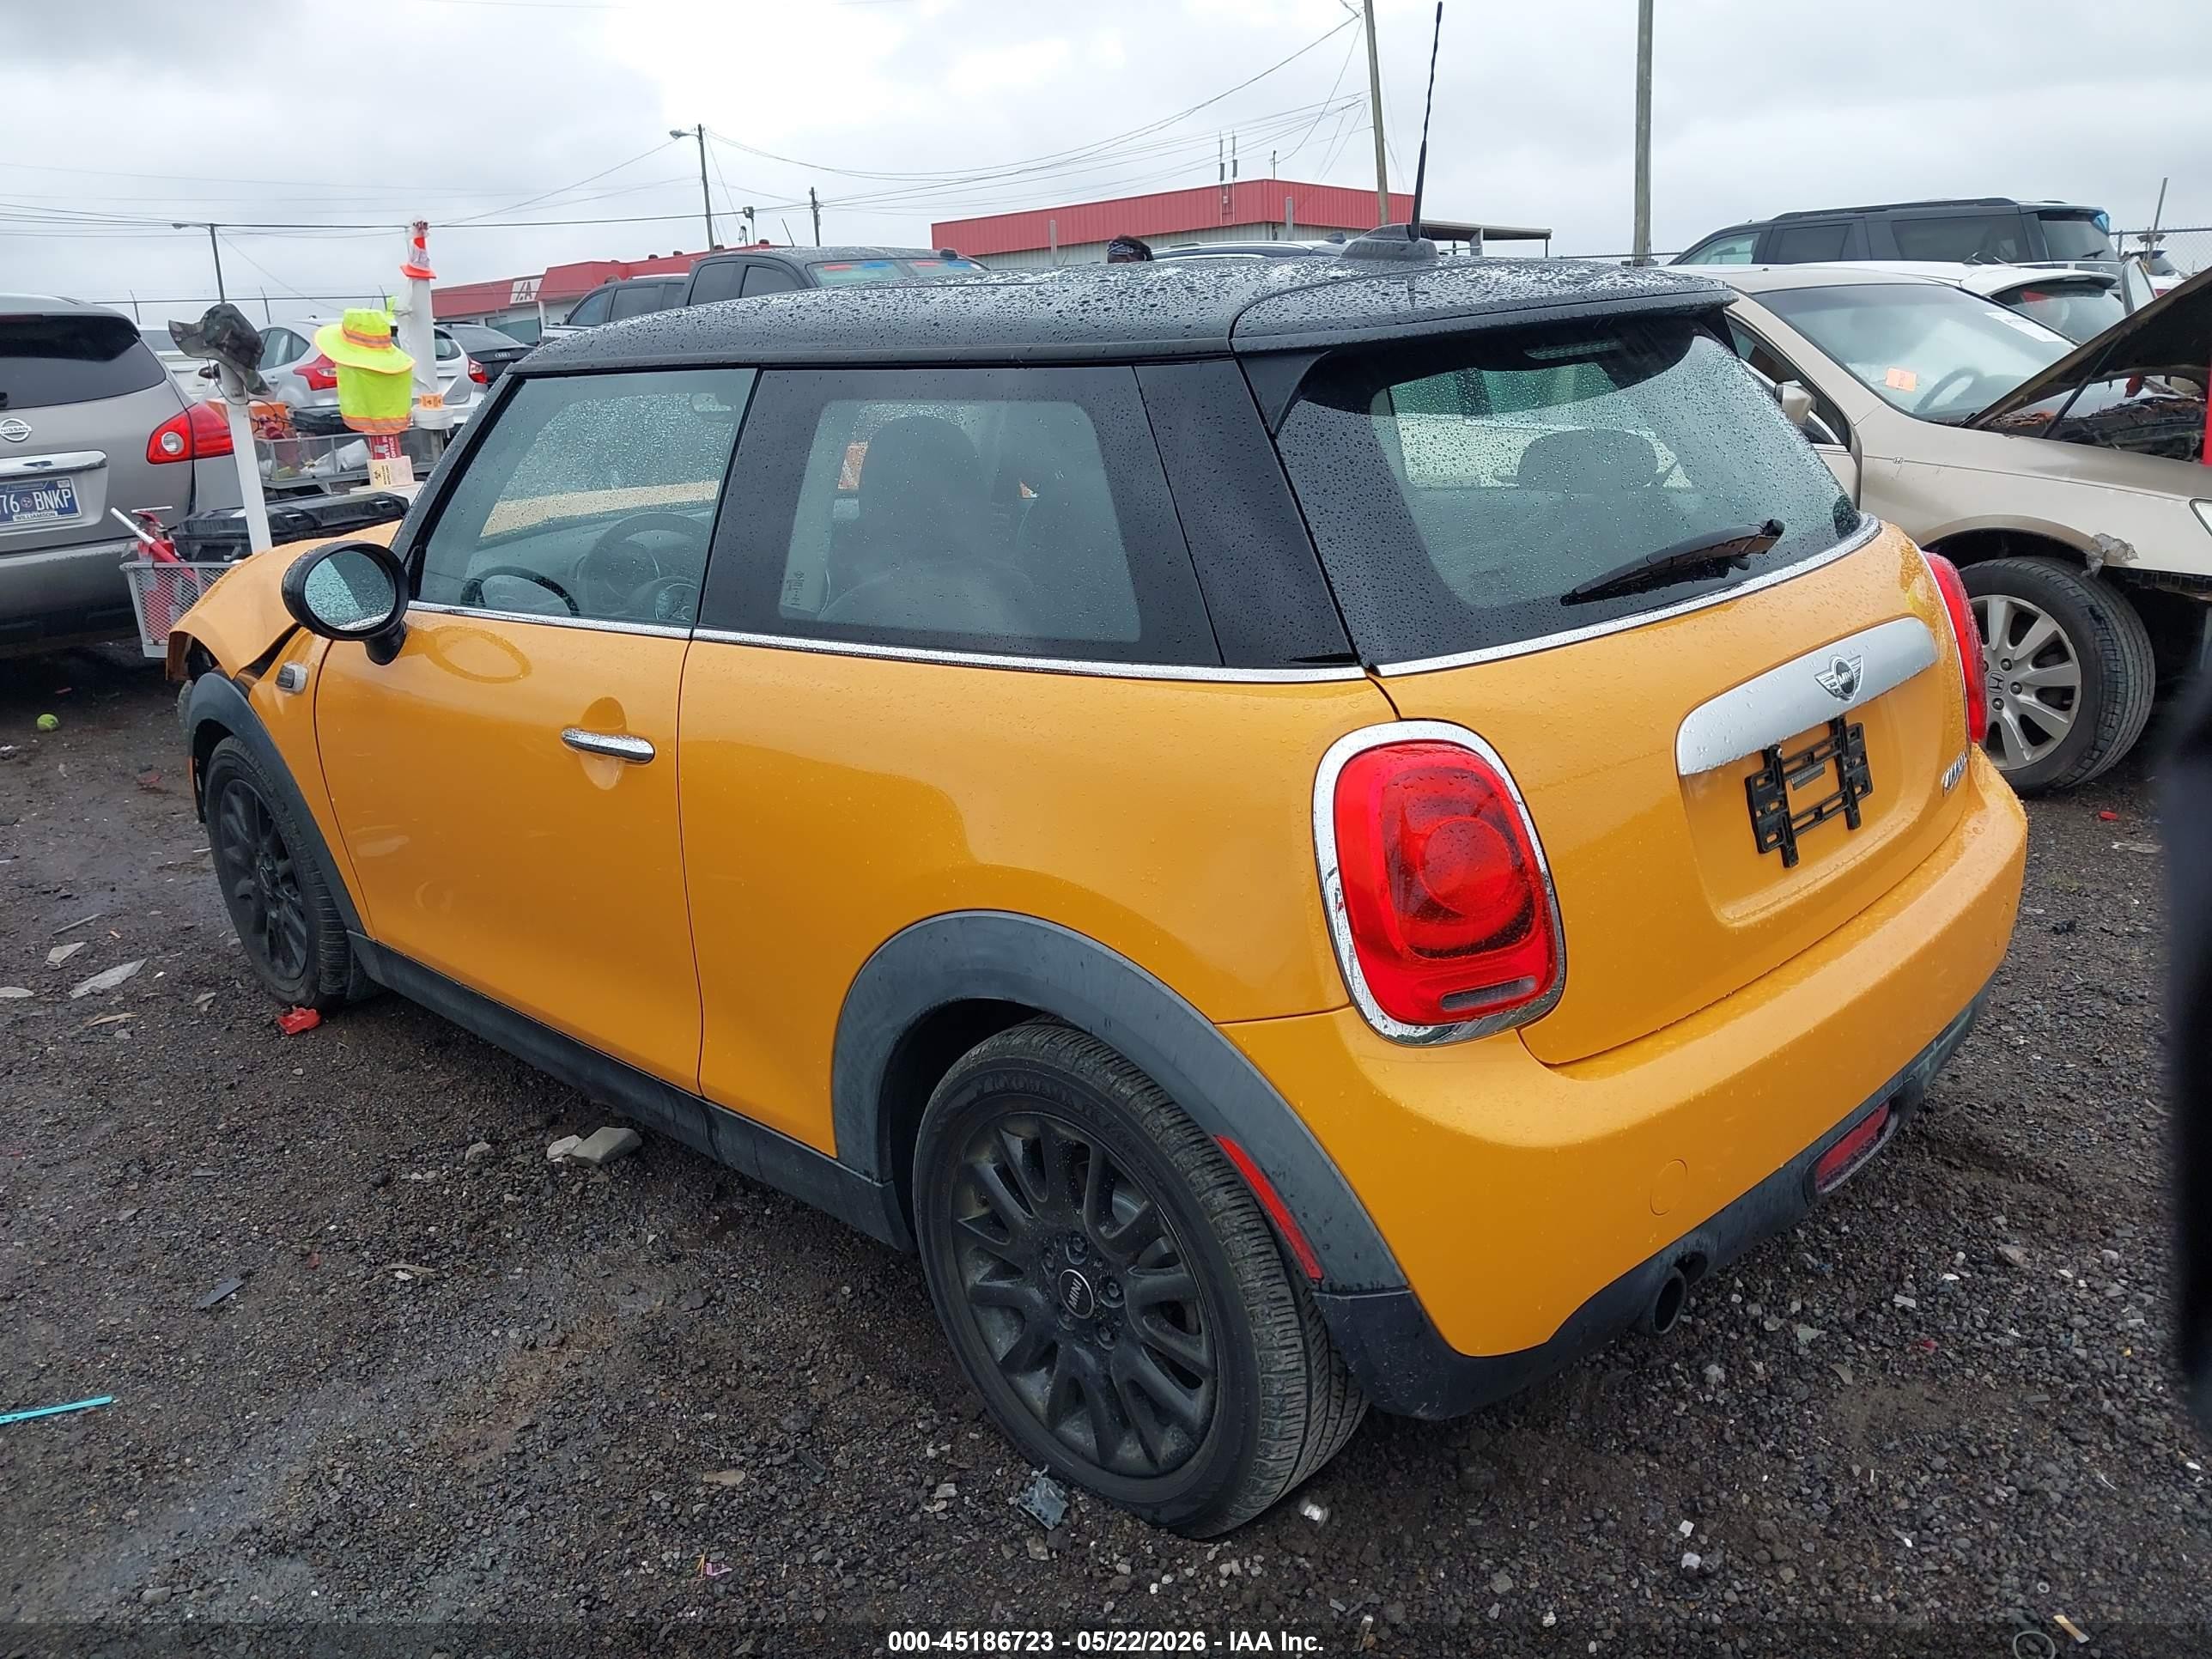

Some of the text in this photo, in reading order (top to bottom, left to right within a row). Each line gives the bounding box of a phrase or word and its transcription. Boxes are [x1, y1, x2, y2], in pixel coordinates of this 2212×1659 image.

[0, 489, 71, 514] 76 BNKP
[1067, 1278, 1083, 1310] MINI
